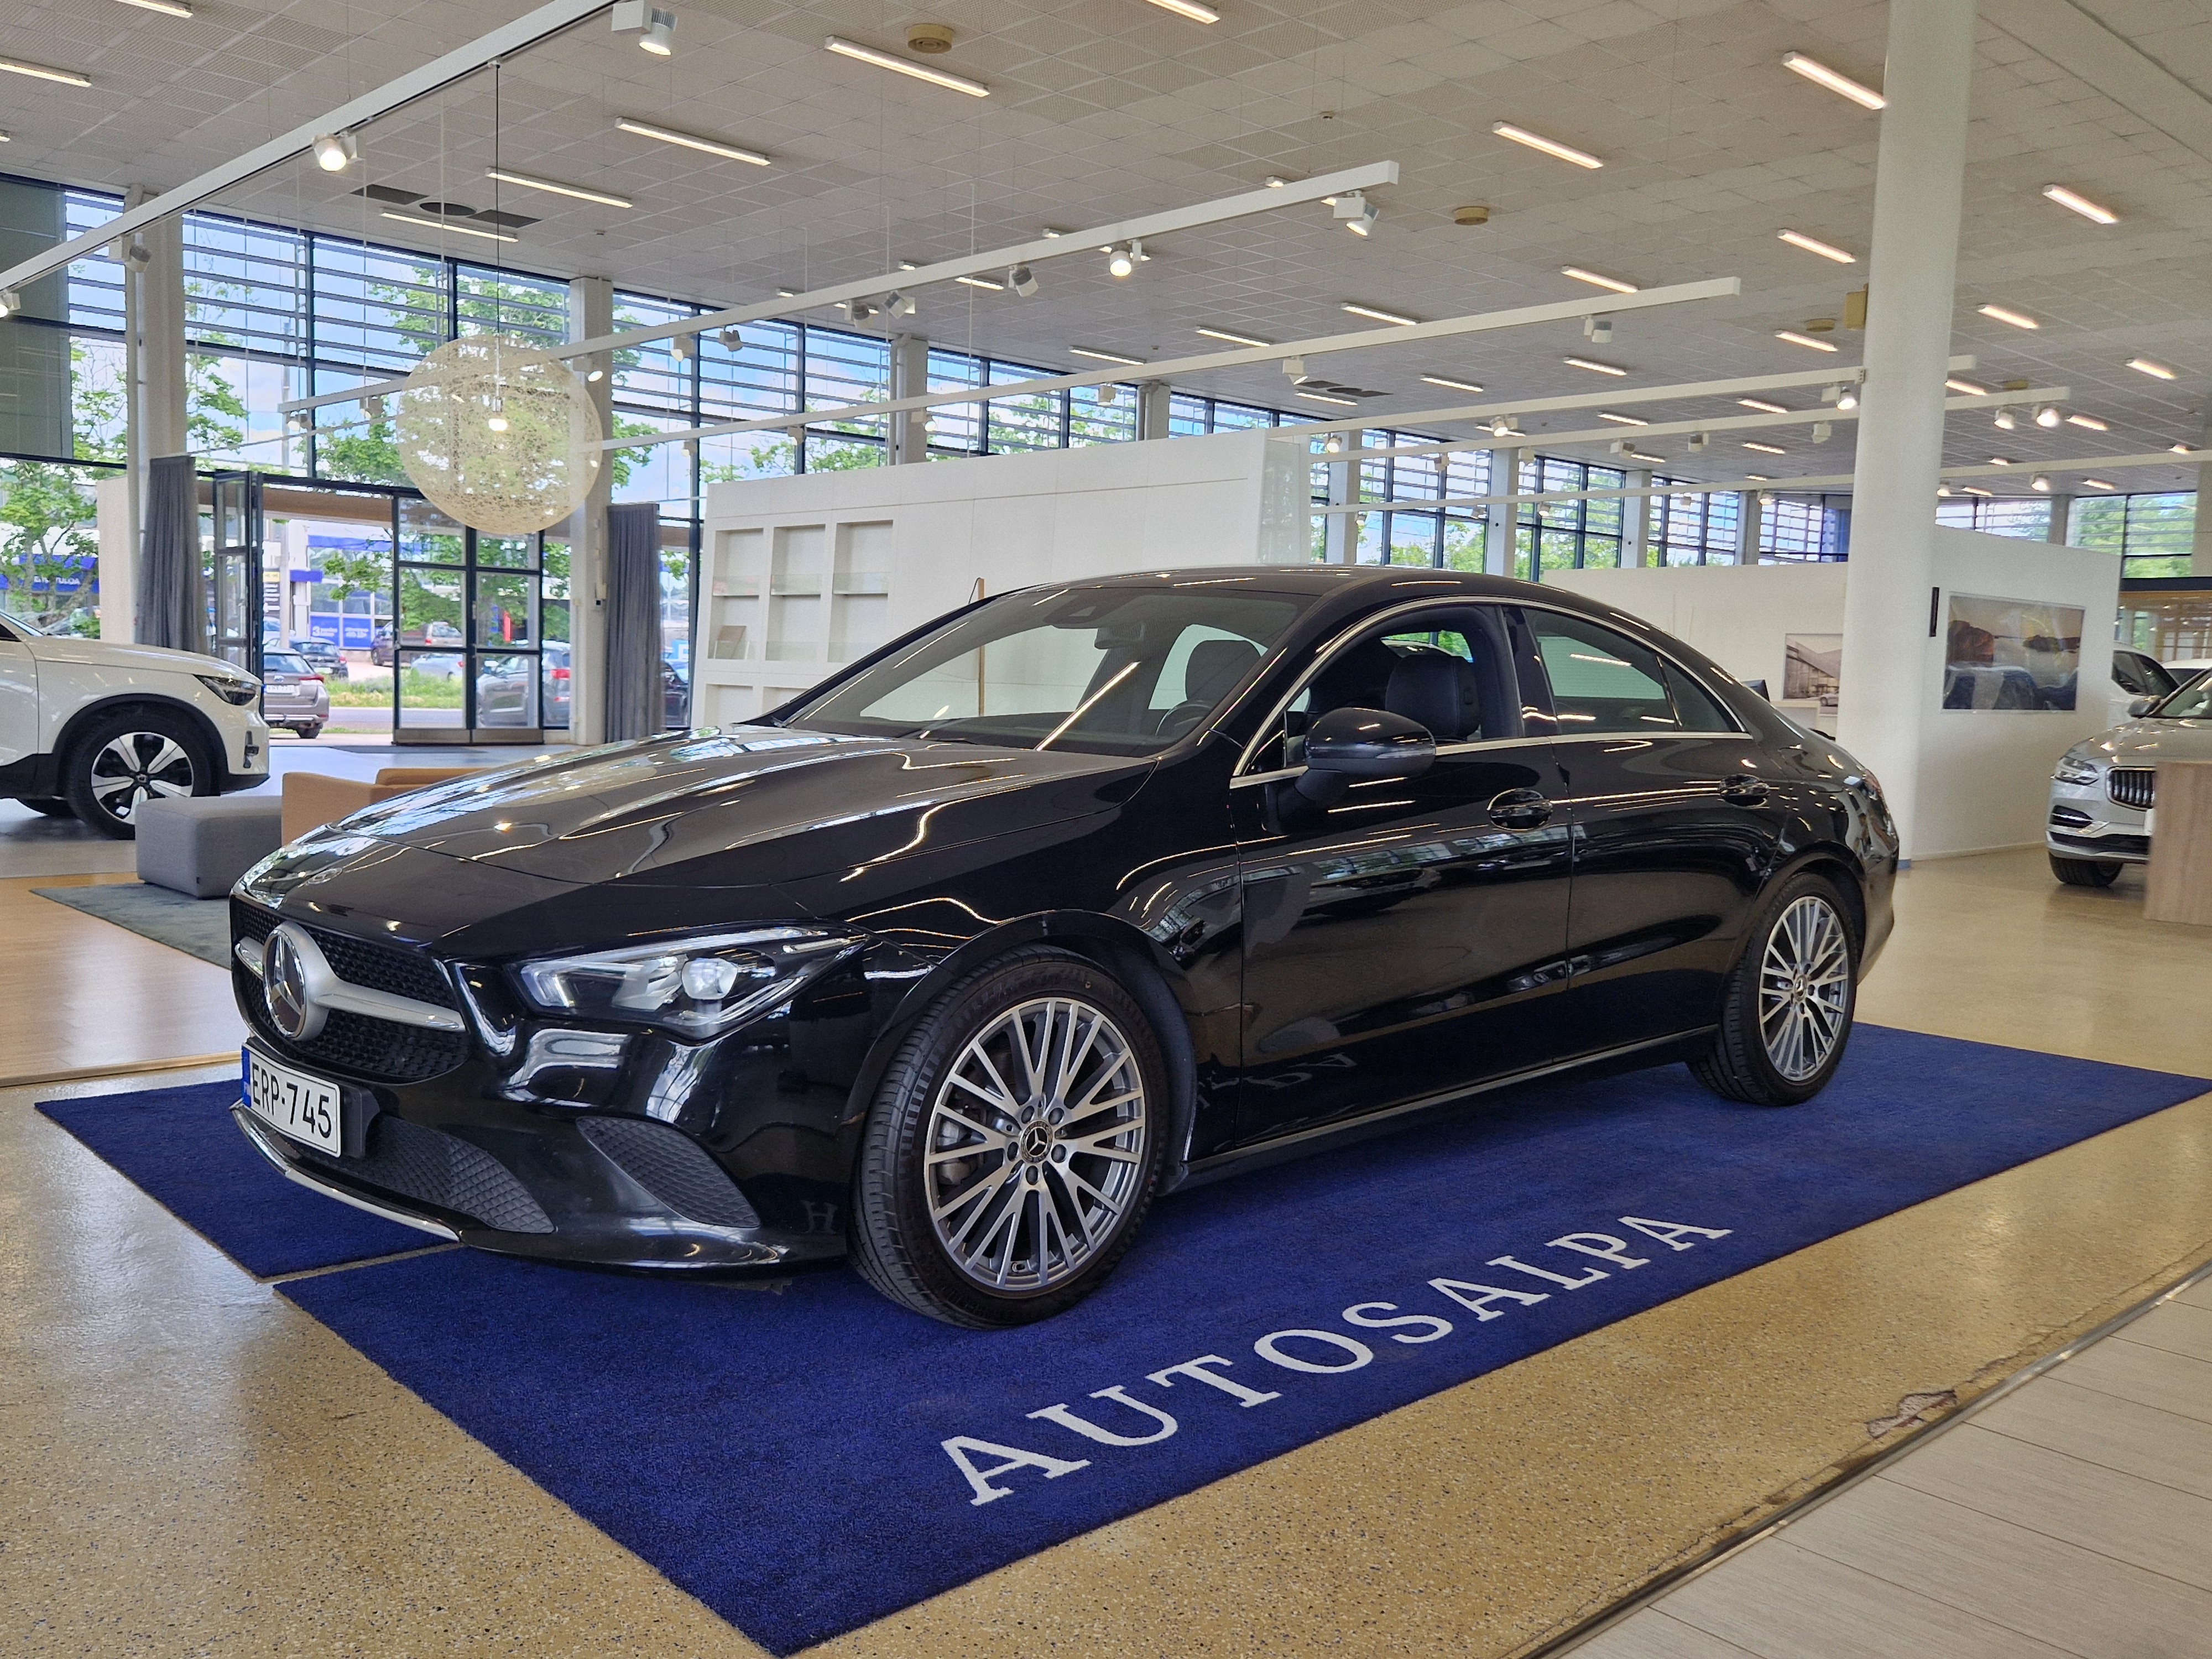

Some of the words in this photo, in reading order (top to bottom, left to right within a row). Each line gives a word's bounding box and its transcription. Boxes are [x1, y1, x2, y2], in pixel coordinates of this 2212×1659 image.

[312, 626, 320, 637] 3
[252, 1062, 331, 1138] ERP-745
[941, 1215, 1733, 1506] AUTOSALPA
